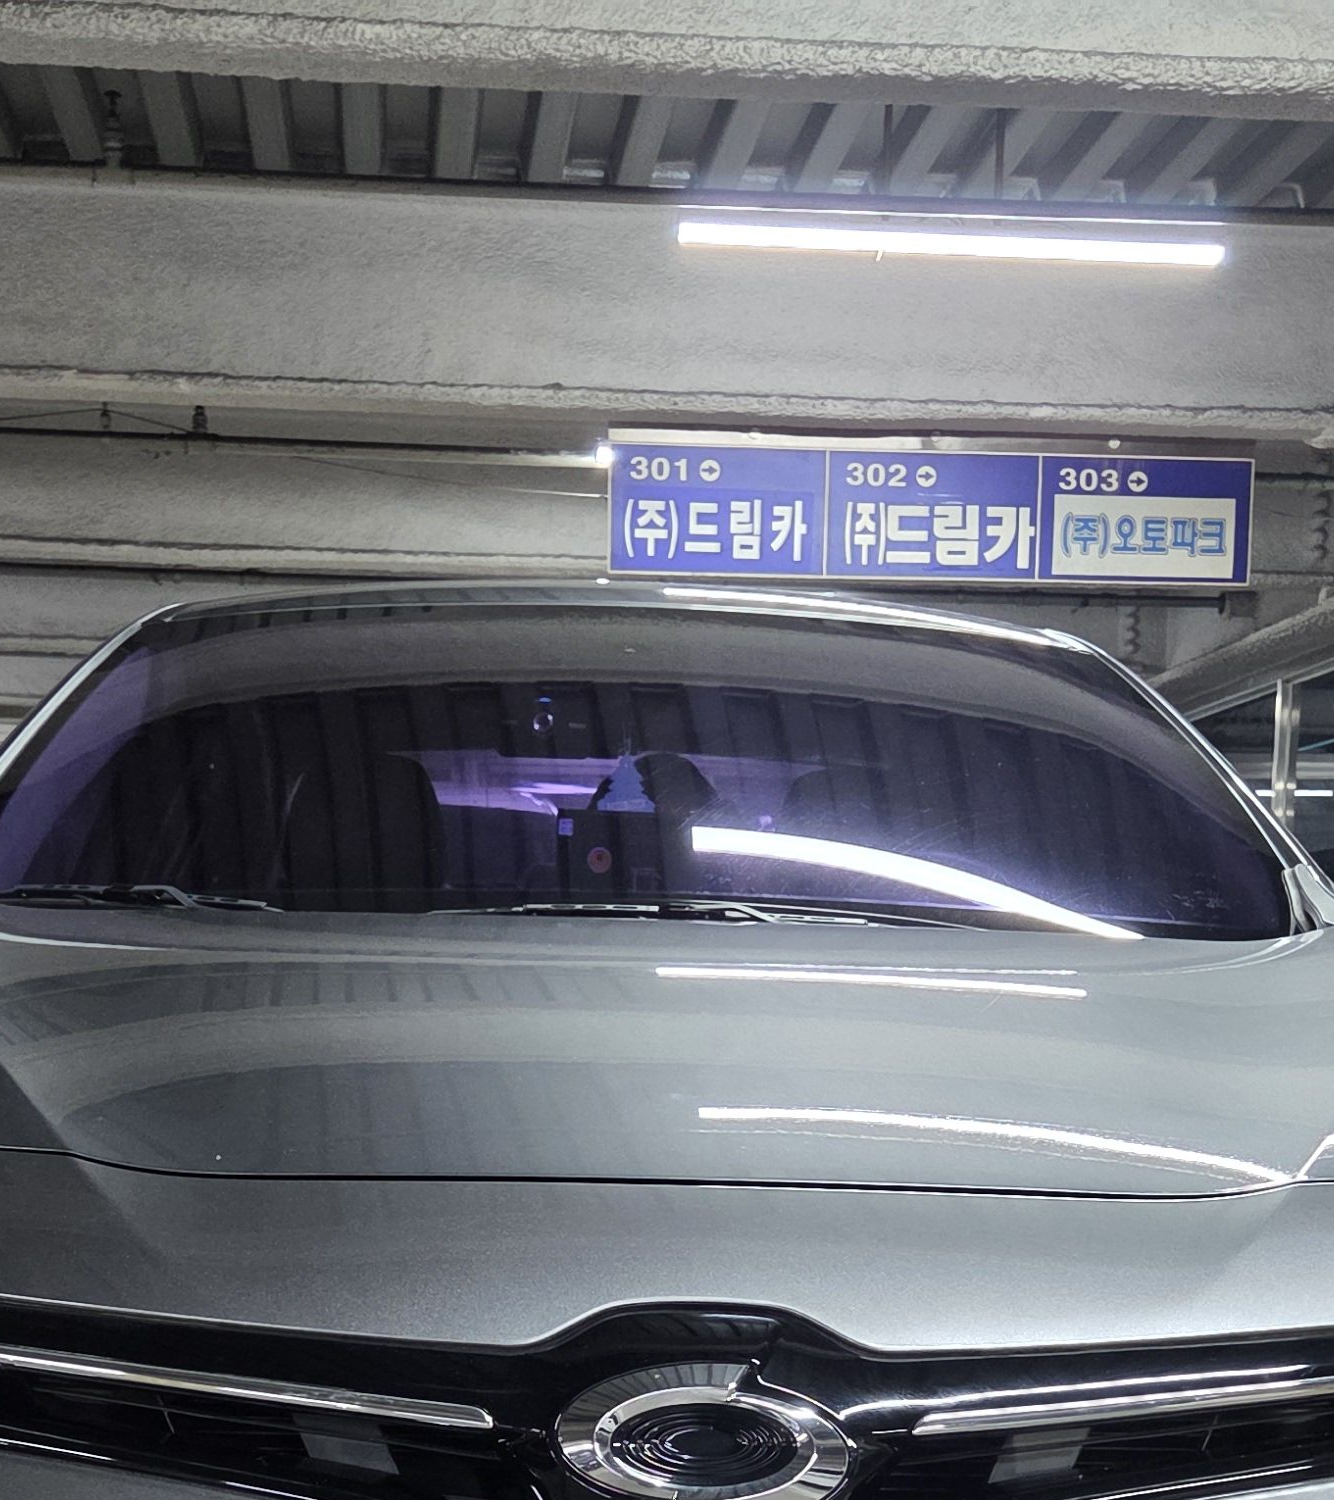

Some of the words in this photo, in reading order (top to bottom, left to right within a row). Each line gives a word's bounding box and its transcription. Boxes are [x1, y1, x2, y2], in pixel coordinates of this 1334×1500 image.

[629, 456, 689, 482] 301
[845, 462, 908, 489] 302
[1058, 467, 1120, 492] 303
[623, 497, 808, 562] (주)드림카
[844, 500, 1037, 570] (주)드림카
[1061, 510, 1228, 558] (주)오토파크
